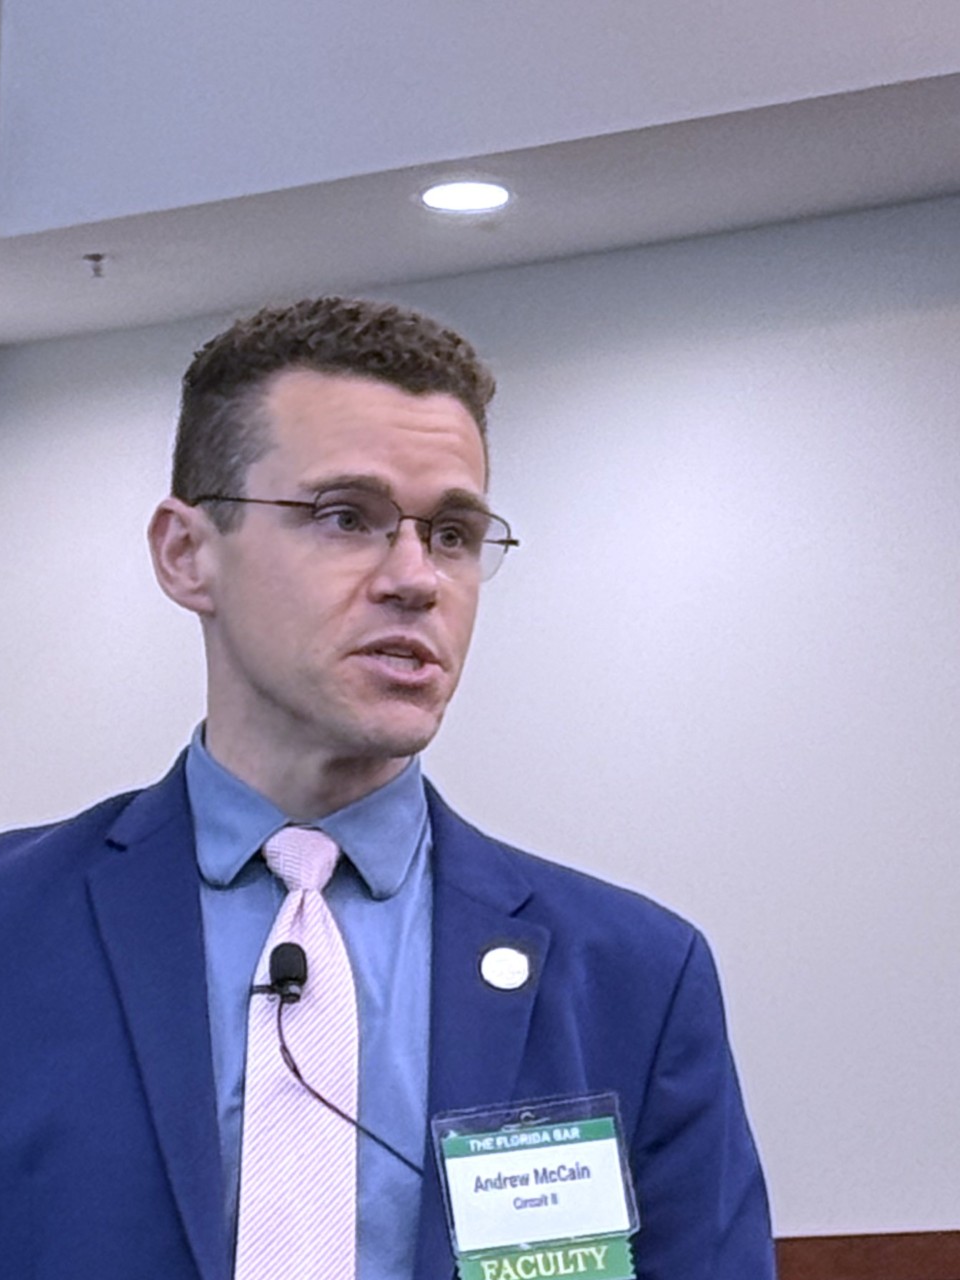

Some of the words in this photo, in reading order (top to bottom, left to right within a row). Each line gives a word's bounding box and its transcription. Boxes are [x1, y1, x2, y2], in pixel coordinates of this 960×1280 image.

[468, 1136, 495, 1152] THE
[496, 1130, 551, 1148] FLORIDA
[553, 1127, 581, 1142] BAR
[474, 1172, 530, 1193] Andrew
[534, 1162, 591, 1186] McCain
